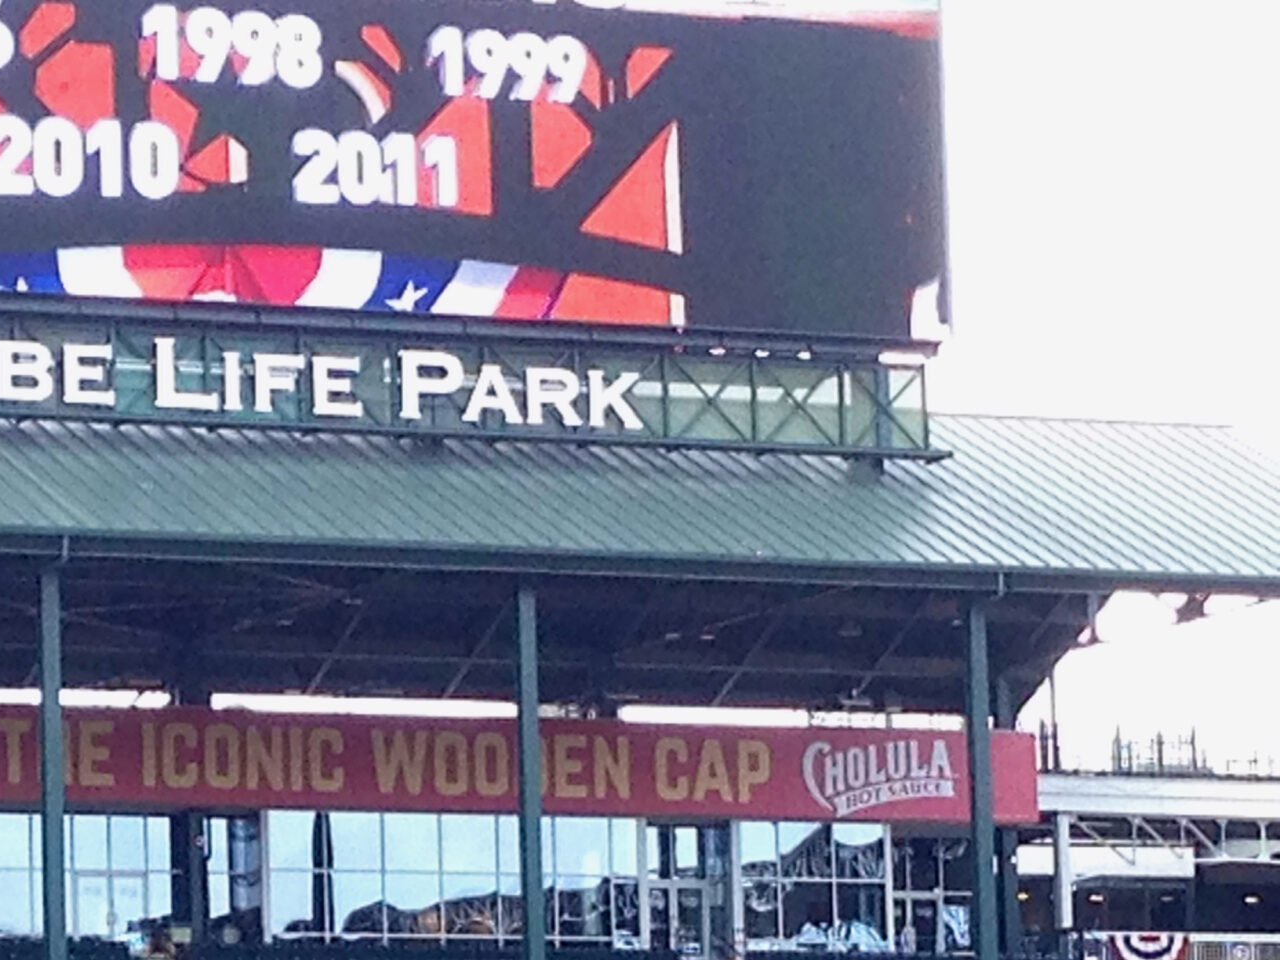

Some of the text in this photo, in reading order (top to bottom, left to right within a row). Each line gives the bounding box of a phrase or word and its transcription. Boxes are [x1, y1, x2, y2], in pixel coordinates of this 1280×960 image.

[140, 4, 323, 89] 1998
[428, 24, 587, 104] 1999
[292, 128, 459, 208] 2011
[140, 720, 346, 793] ICONIC
[654, 736, 772, 805] CAP
[802, 739, 954, 812] CHOLULA
[845, 786, 882, 809] HOT
